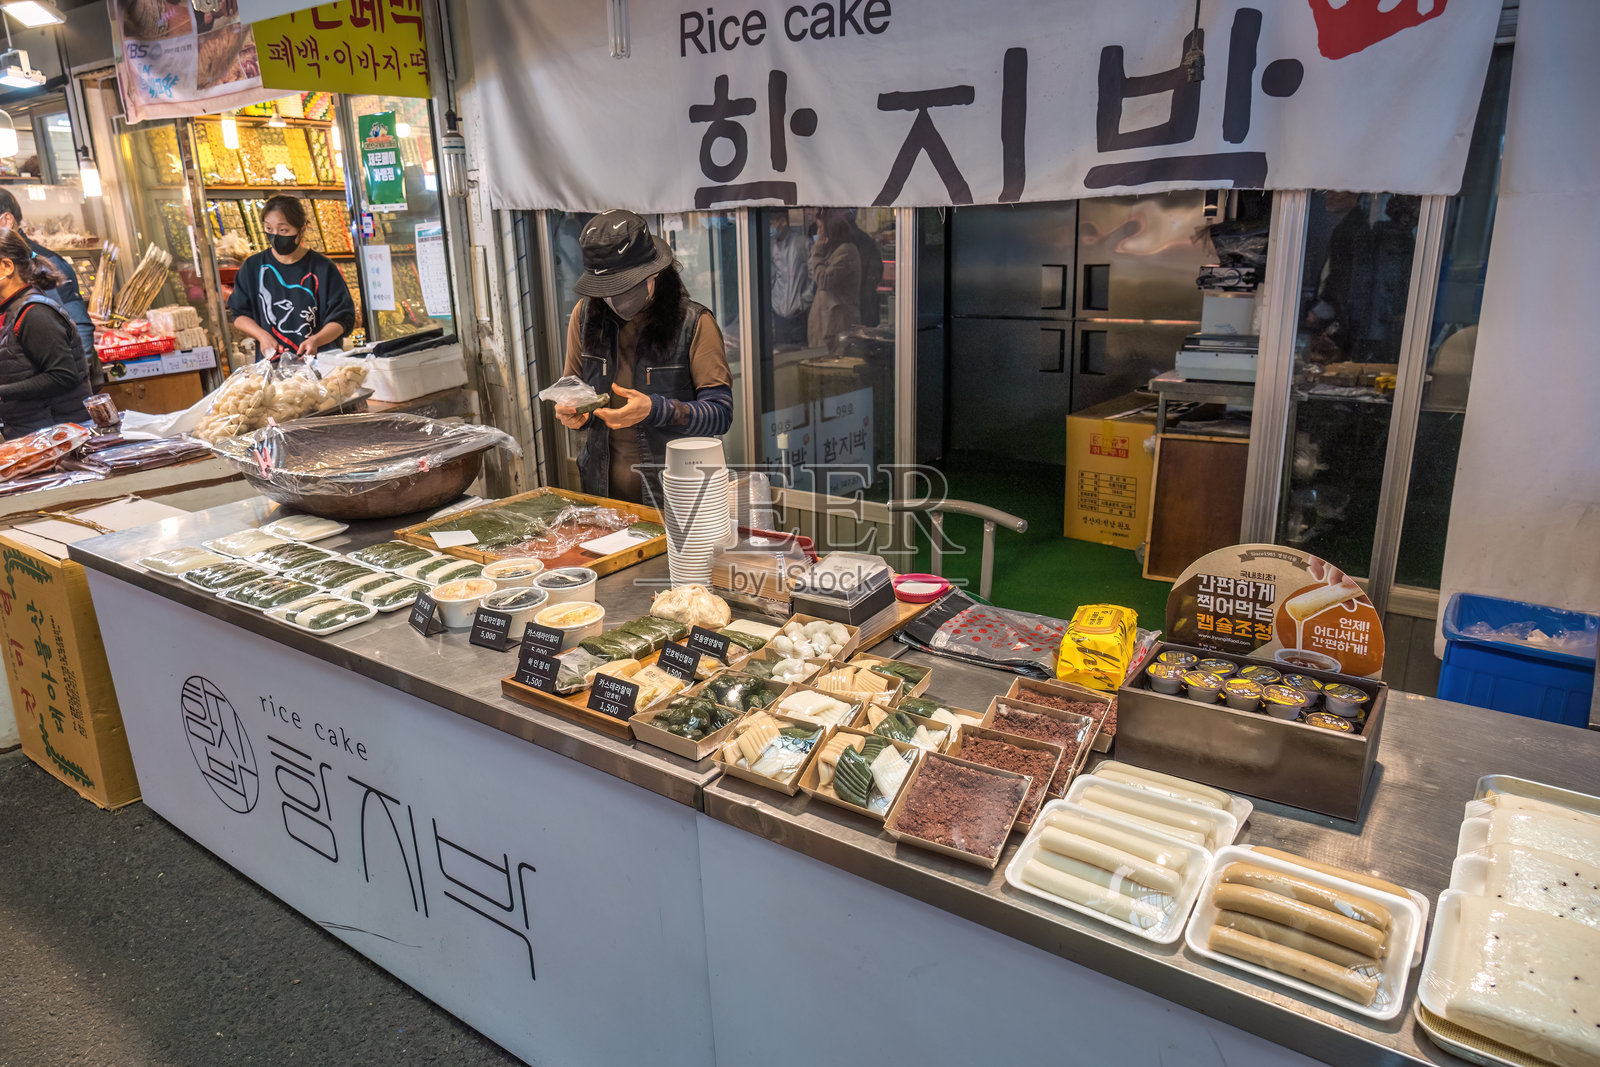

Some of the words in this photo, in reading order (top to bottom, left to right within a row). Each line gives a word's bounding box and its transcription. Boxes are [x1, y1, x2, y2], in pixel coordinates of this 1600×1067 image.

[679, 8, 767, 57] Rice
[784, 0, 892, 43] cake
[126, 42, 150, 60] BS
[367, 150, 396, 166] 제로페이
[823, 428, 868, 464] 함지박
[1240, 571, 1276, 582] 국내최초!
[1196, 573, 1276, 602] 간편하게
[1196, 593, 1275, 622] 찍어먹는
[1196, 613, 1273, 641] 캡슐조청
[1339, 617, 1370, 632] 언제!
[480, 630, 497, 641] 5,000
[527, 629, 560, 644] 카스테라인절미
[1313, 625, 1369, 644] 어디서나!
[1311, 636, 1368, 656] 간편하게!
[665, 647, 694, 666] 단호박인절미
[525, 675, 543, 688] 1,500
[666, 666, 682, 679] 1,500
[599, 678, 632, 697] 카스테라찰떡
[604, 690, 621, 702] (단호박)
[599, 701, 619, 715] 1,500
[259, 694, 303, 730] rice
[313, 719, 369, 762] cake
[267, 734, 537, 981] 함지박
